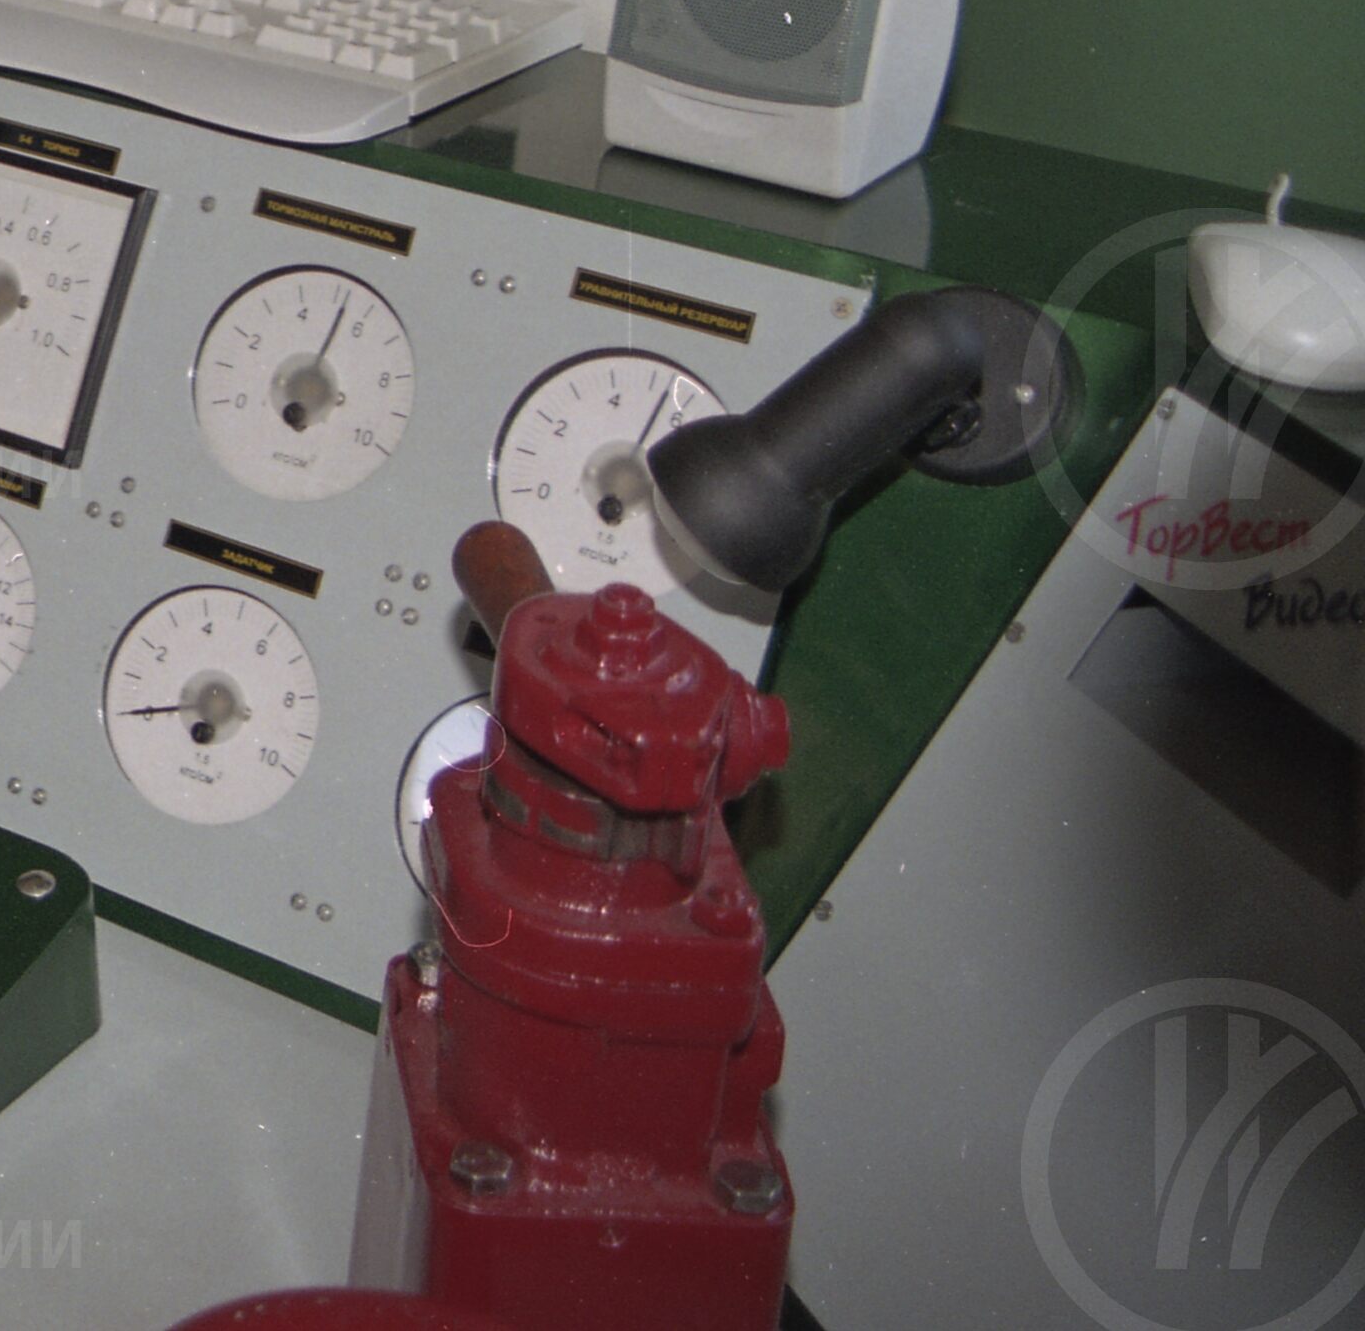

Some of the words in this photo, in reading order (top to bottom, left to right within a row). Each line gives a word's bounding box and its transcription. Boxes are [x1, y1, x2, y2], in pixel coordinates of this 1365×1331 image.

[297, 307, 308, 321] 4
[579, 280, 678, 315] УРАВНИТЕЛЬНЫЙ
[679, 307, 748, 332] РЕЗЕРВУАР
[351, 321, 364, 338] 6
[248, 333, 261, 350] 2
[379, 372, 390, 388] 8
[234, 393, 247, 409] 0
[608, 393, 621, 409] 4
[553, 419, 568, 437] 2
[670, 412, 683, 428] 6
[354, 427, 373, 446] 10
[537, 483, 550, 500] 0
[201, 621, 212, 635] 4
[155, 646, 167, 662] 2
[256, 639, 268, 656] 6
[283, 691, 295, 708] 8
[259, 747, 279, 766] 10
